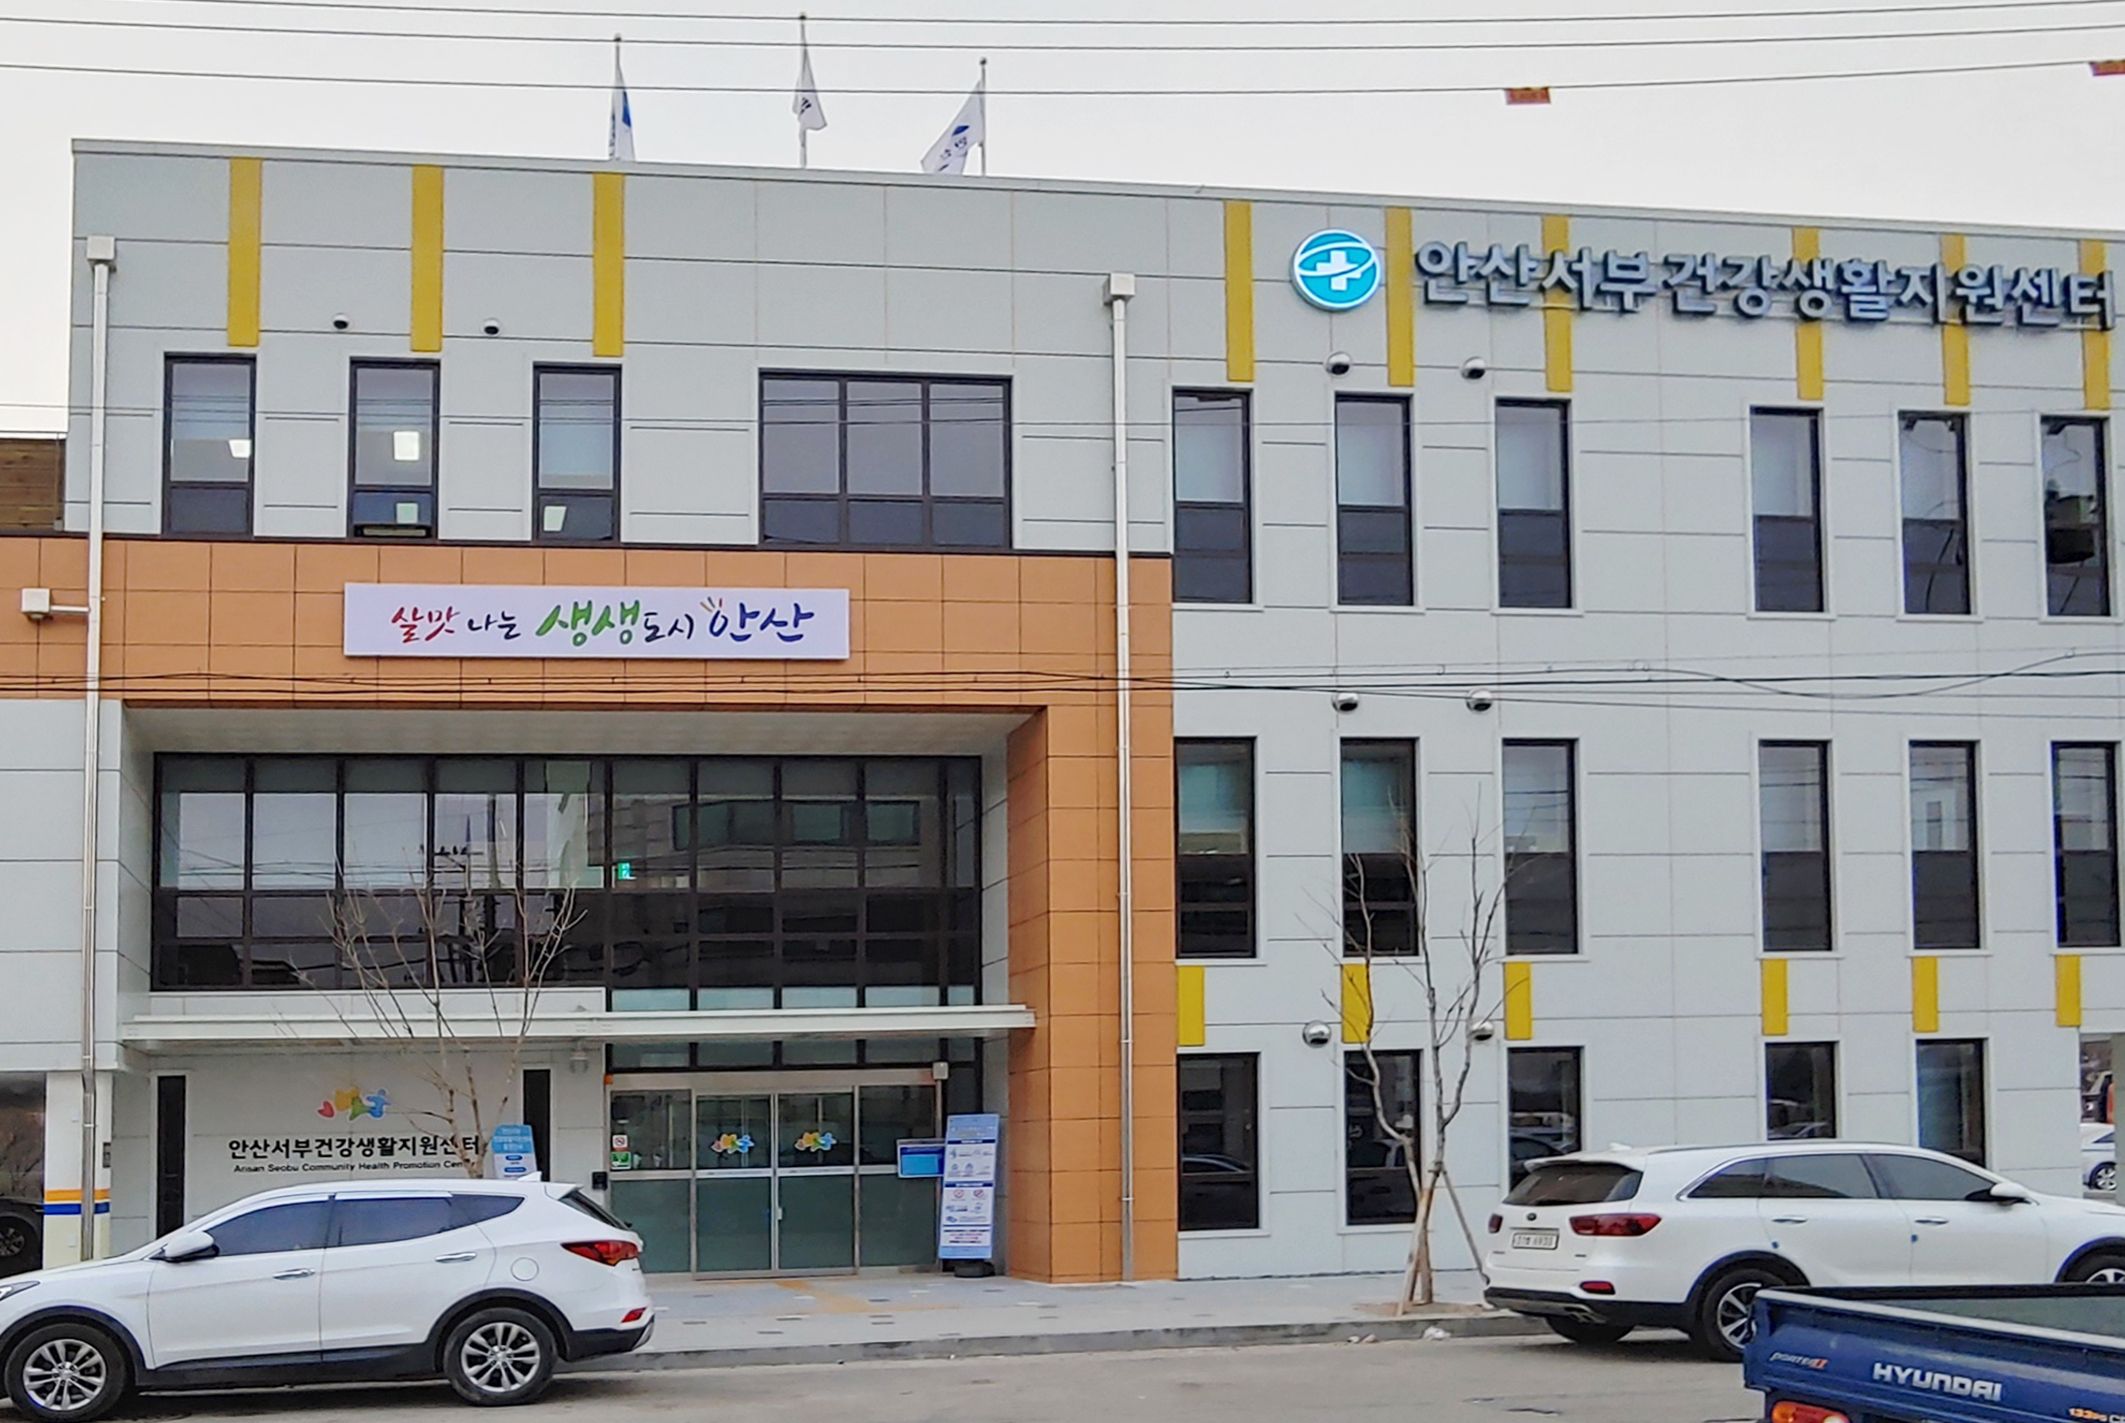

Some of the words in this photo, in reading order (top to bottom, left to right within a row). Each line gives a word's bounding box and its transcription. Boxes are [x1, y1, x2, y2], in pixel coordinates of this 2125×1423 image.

[1415, 240, 2116, 331] 안산서부건강생활지원센터
[391, 605, 461, 644] 살맛
[467, 610, 521, 641] 나는
[705, 599, 815, 643] 안산
[268, 1163, 299, 1172] Seobu
[302, 1163, 355, 1172] Community
[358, 1162, 390, 1171] Health
[393, 1161, 441, 1170] Promotion
[1872, 1361, 2003, 1402] HYUNDAI
